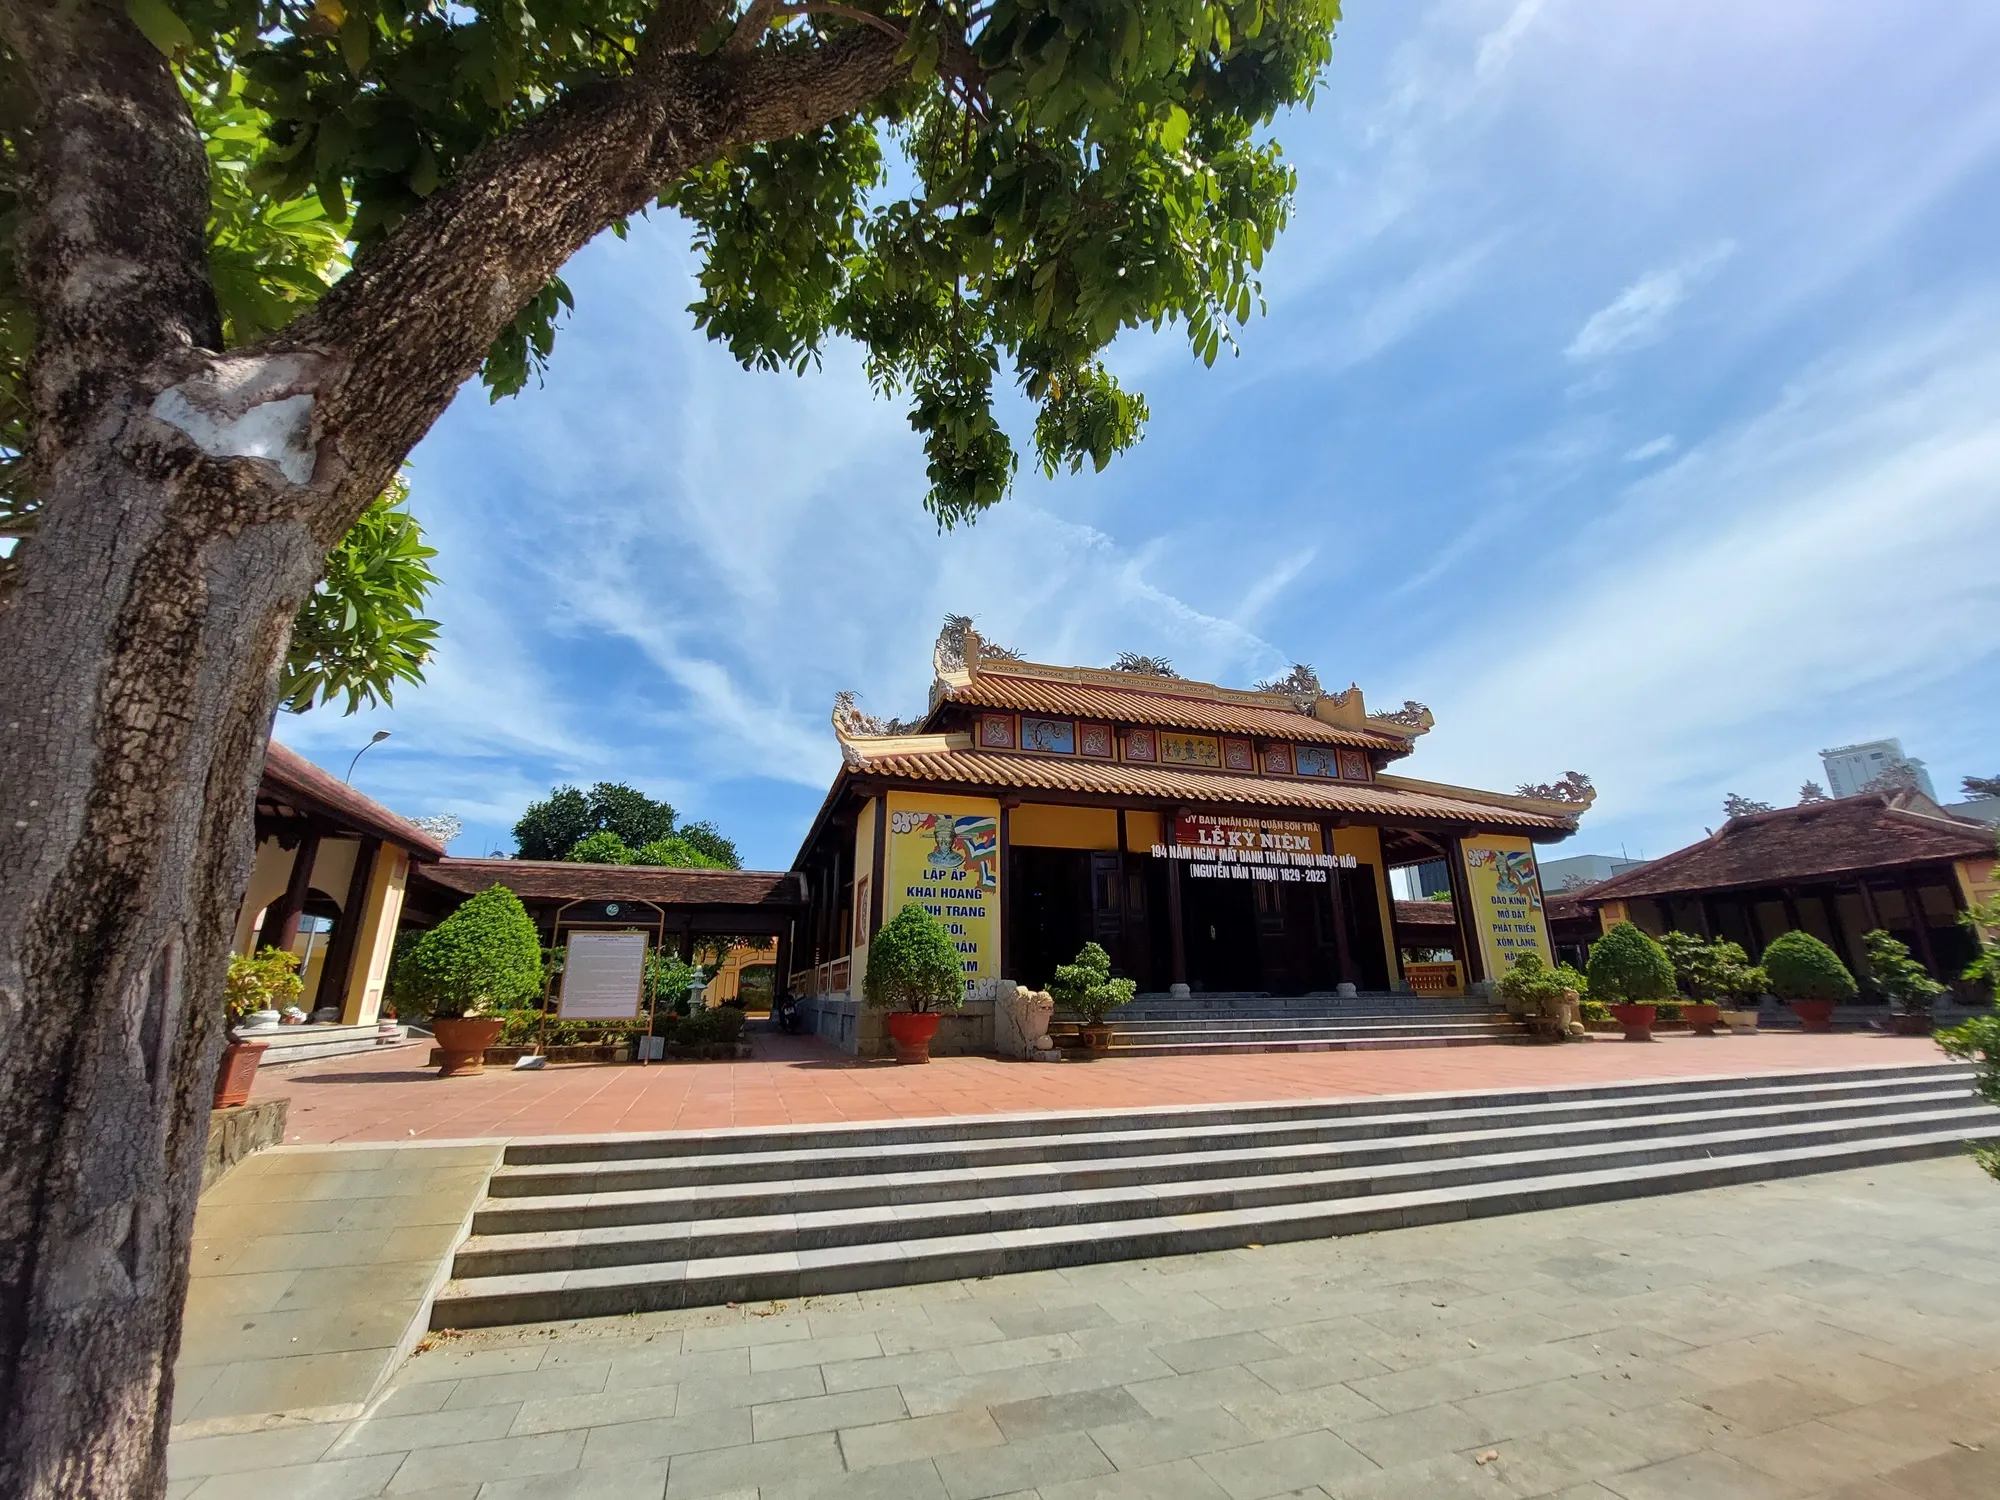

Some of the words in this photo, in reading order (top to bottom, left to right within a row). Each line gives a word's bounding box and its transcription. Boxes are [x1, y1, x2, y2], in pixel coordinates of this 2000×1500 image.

[1199, 815, 1217, 825] BAN
[1218, 816, 1241, 826] NHÂN
[1243, 817, 1259, 828] DÂN
[1261, 819, 1284, 831] QUẬN
[1285, 821, 1300, 831] SƠN
[1302, 821, 1319, 832] TRÀ
[1198, 825, 1225, 845] LỄ
[1228, 828, 1256, 847] KỶ
[1261, 833, 1310, 851] NIỆM
[1151, 844, 1167, 858] 194
[1169, 843, 1192, 860] NĂM
[1193, 846, 1216, 861] NGÀY
[1219, 846, 1237, 862] MẤT
[1239, 849, 1264, 863] DANH
[1289, 852, 1315, 868] THOẠI
[1316, 854, 1338, 869] NGỌC
[923, 868, 947, 882] LẬP
[951, 867, 967, 881] ẤP
[1231, 863, 1249, 879] VĂN
[907, 886, 936, 898] KHAI
[940, 887, 982, 899] HOANG
[1509, 896, 1527, 905] KINH
[945, 905, 986, 917] TRANG
